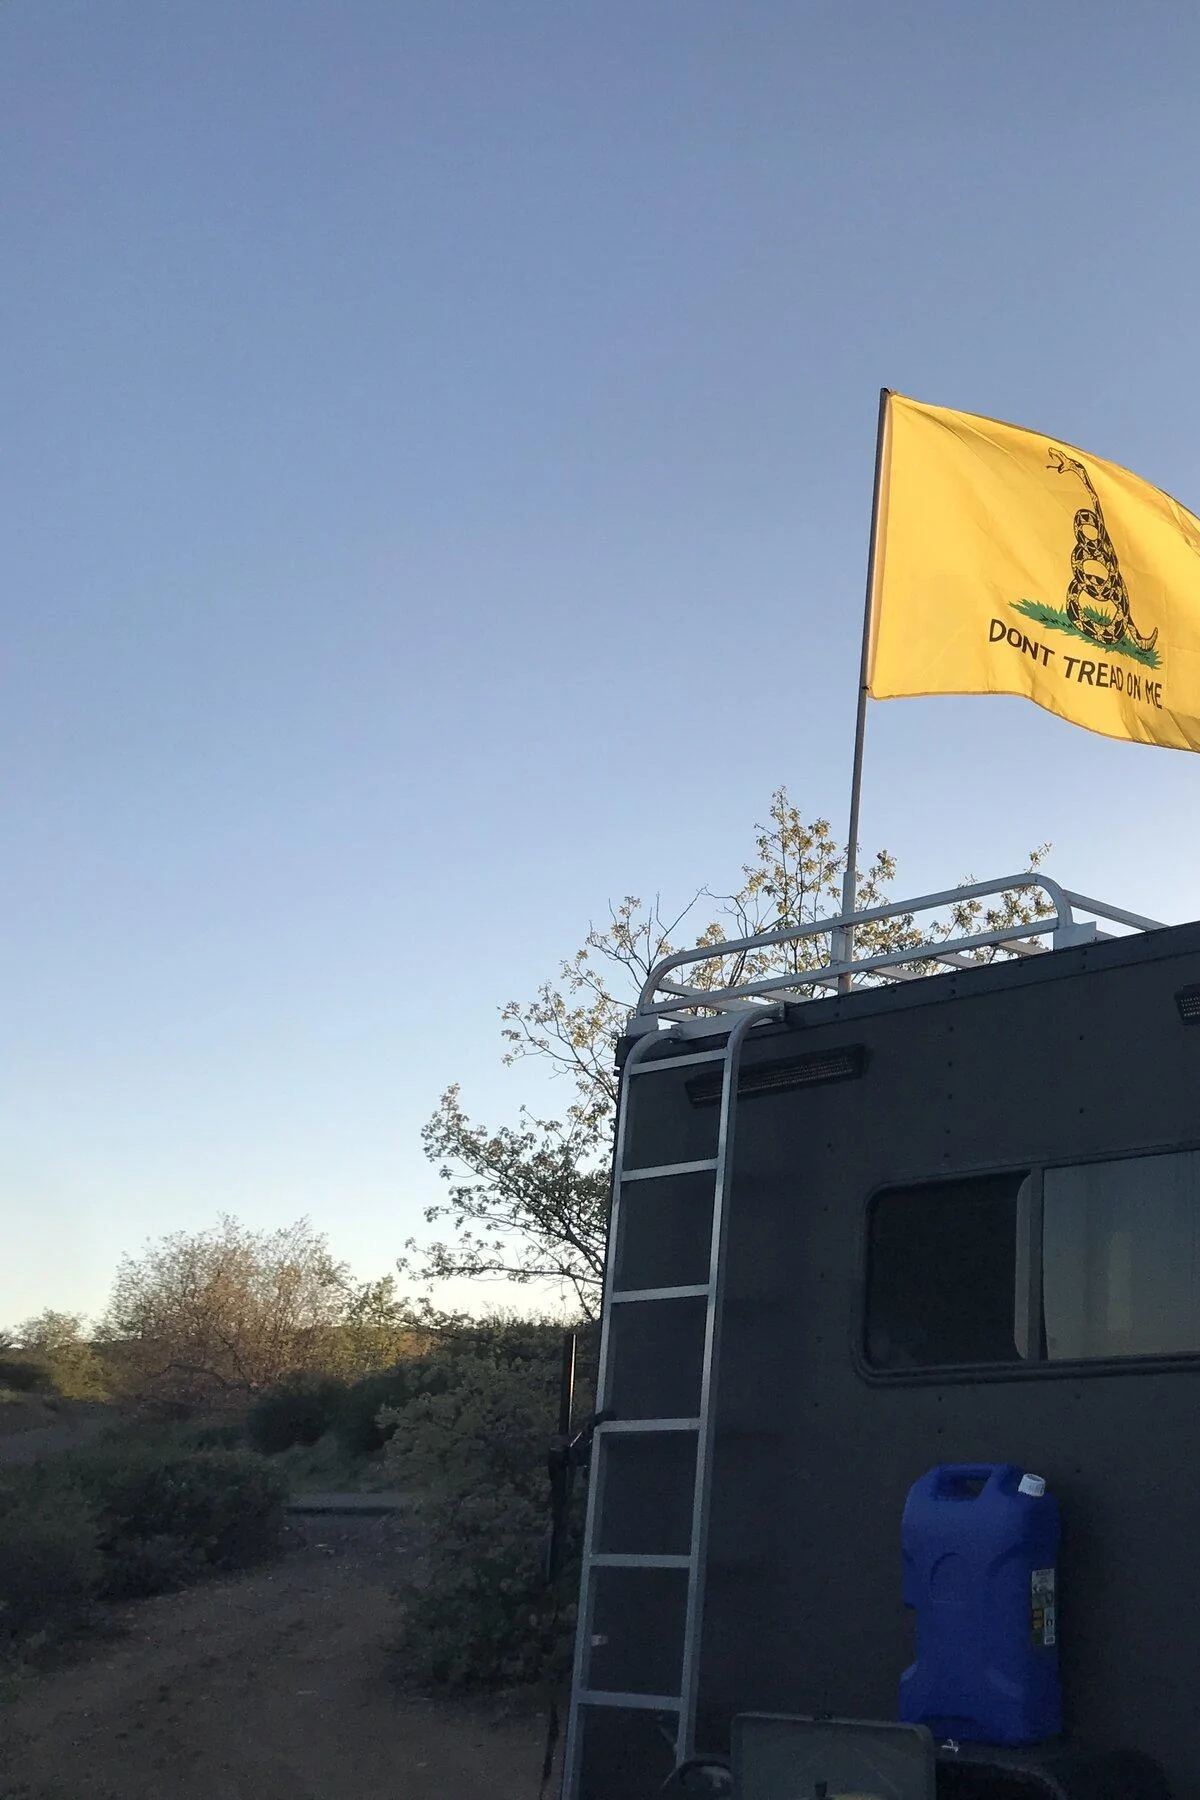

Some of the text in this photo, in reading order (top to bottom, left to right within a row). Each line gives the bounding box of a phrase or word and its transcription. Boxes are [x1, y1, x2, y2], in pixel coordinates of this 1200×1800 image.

[989, 618, 1162, 709] DONT TREAD ON ME
